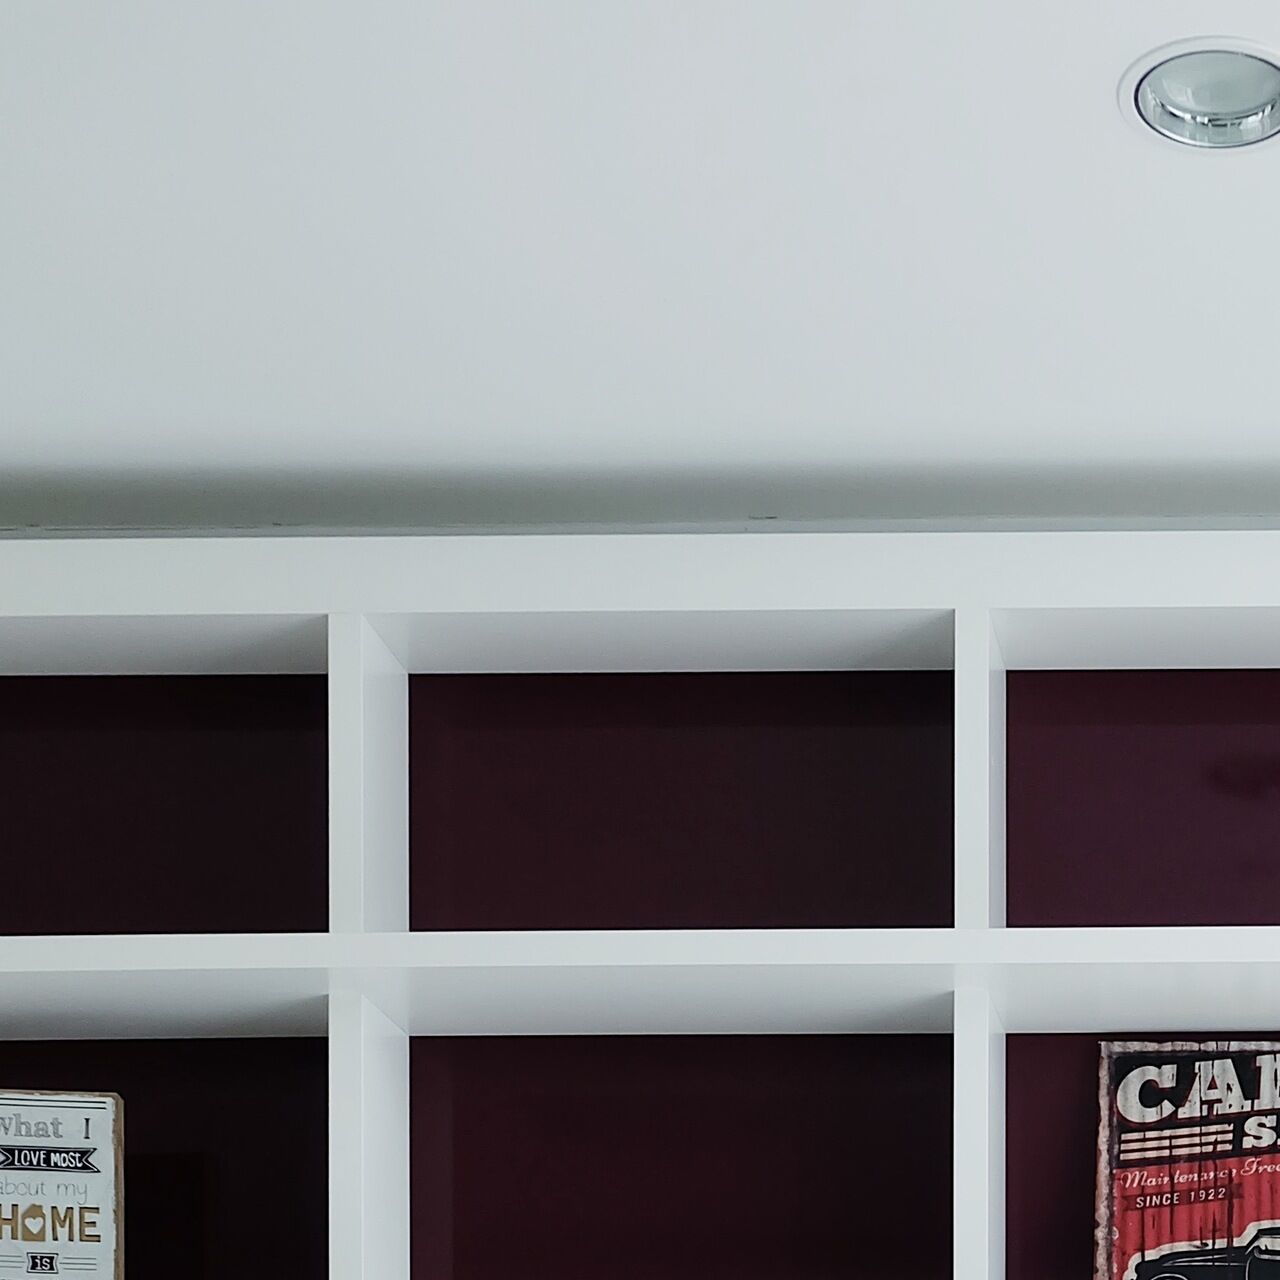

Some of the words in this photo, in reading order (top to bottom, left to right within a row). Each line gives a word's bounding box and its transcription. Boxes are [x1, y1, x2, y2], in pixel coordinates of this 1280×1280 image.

[83, 1117, 91, 1139] I
[14, 1149, 48, 1167] LOVE
[56, 1183, 88, 1206] my
[1136, 1192, 1181, 1208] SINCE
[1190, 1187, 1226, 1202] 1922
[35, 1255, 51, 1270] is
